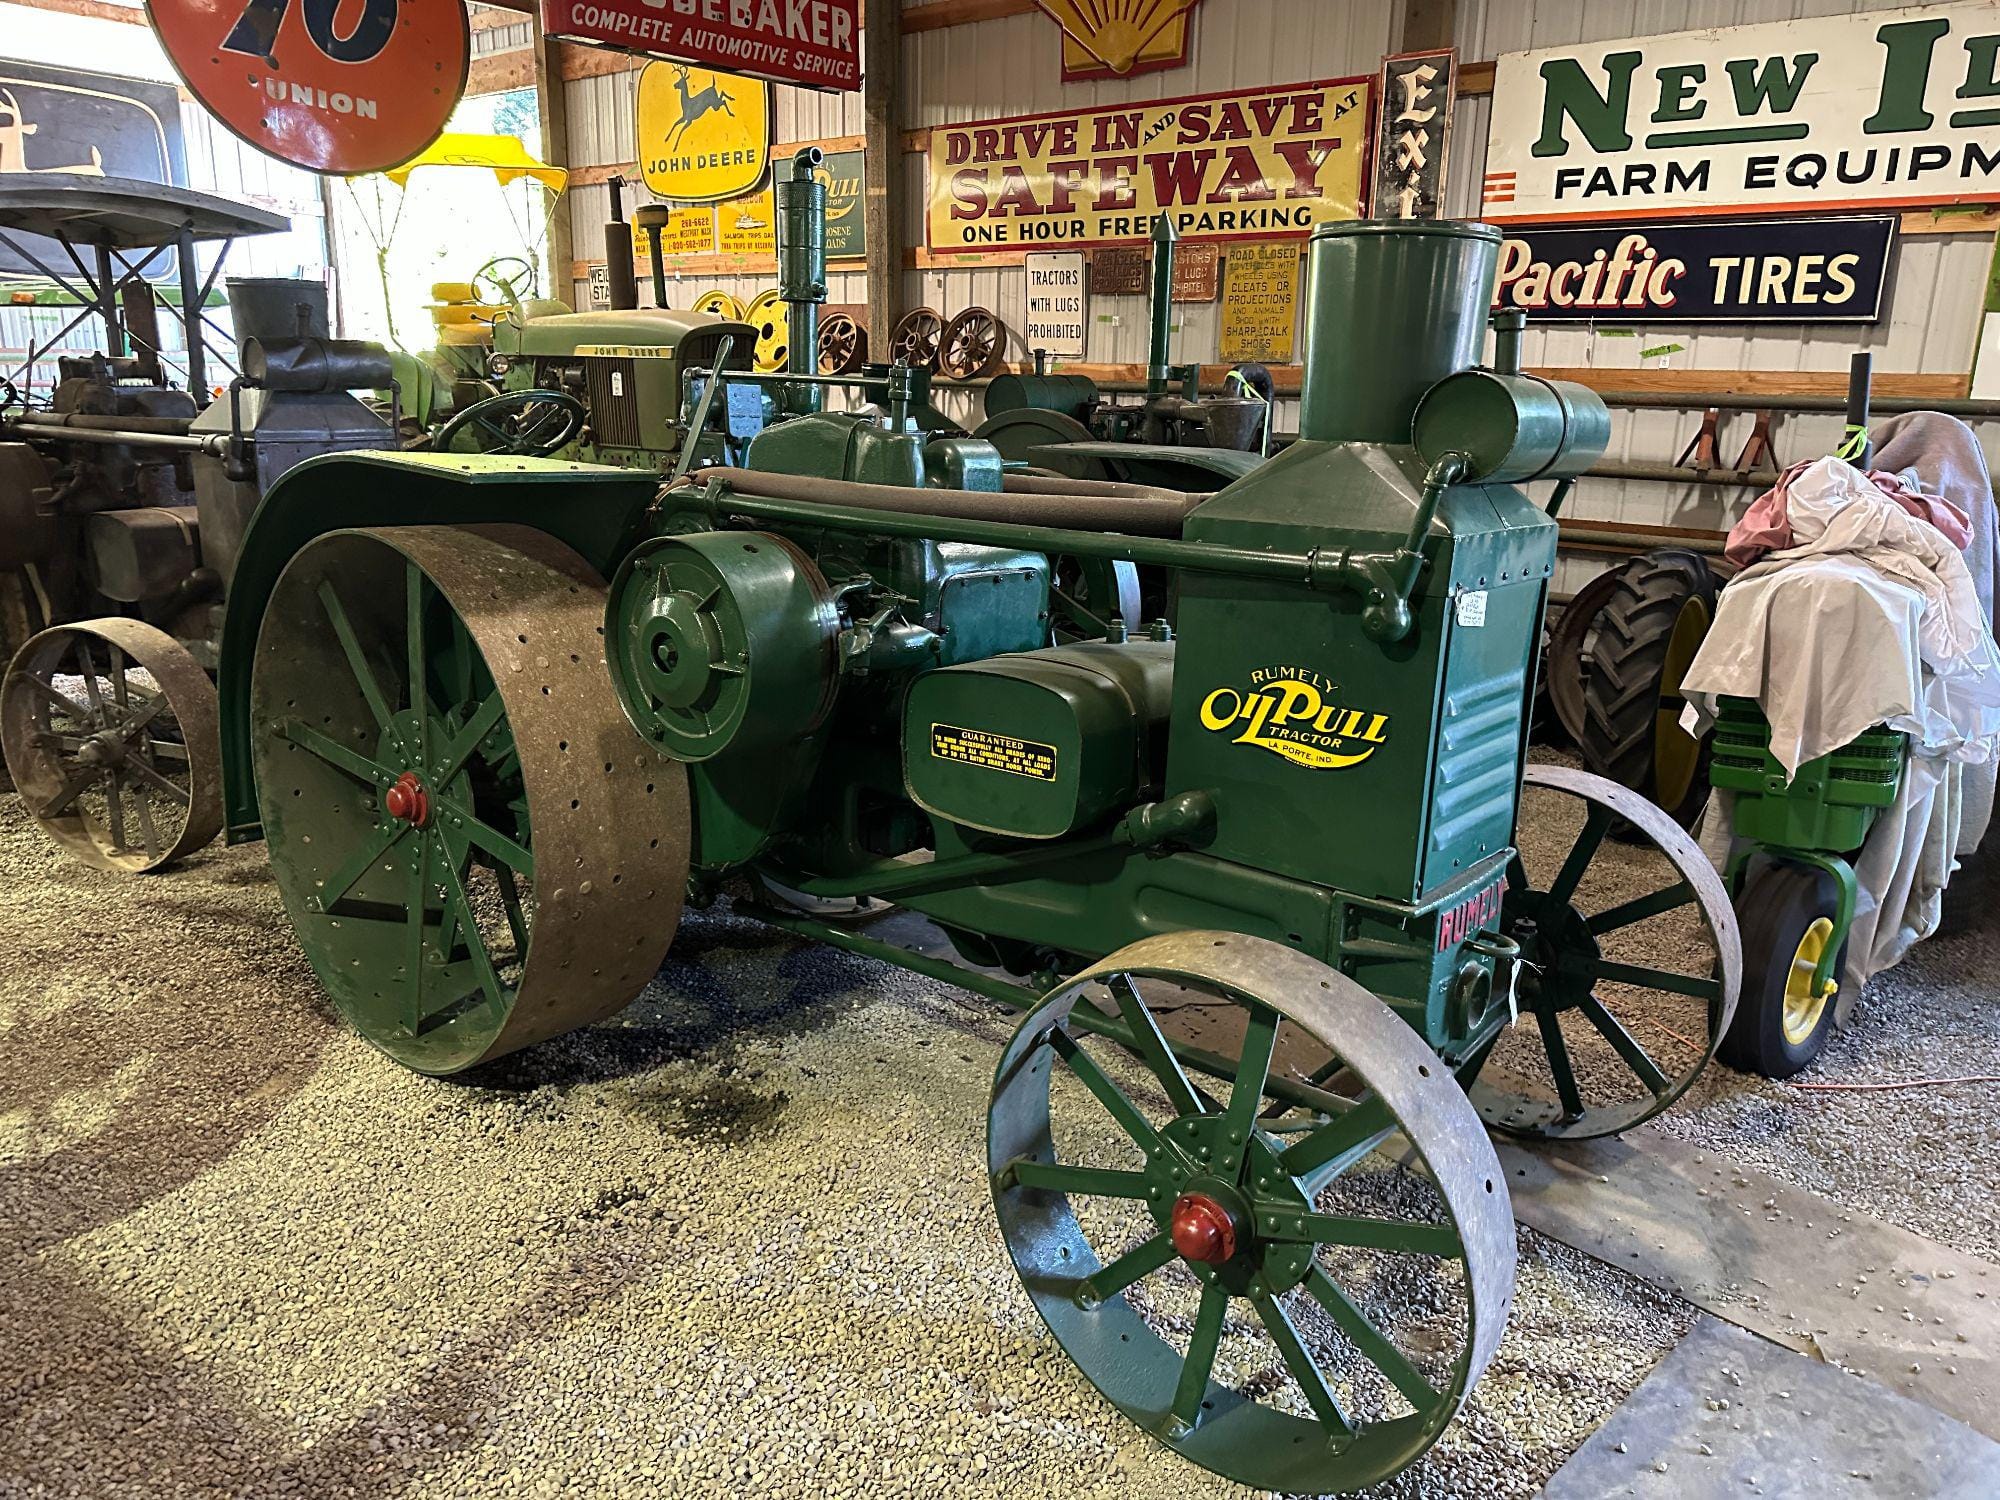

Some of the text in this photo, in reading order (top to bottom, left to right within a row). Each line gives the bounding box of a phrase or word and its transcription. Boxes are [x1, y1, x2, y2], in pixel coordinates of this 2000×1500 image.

[571, 3, 854, 80] COMPLETE AUTOMOTIVE SERVICE
[266, 77, 377, 120] UNION
[946, 91, 1358, 165] DRIVE IN AND SAVE AT
[648, 149, 756, 175] JOHN DEERE
[950, 138, 1342, 220] SAFEWAY
[1555, 143, 2000, 199] FARM EQUIPM
[962, 224, 1008, 243] ONE
[1019, 219, 1085, 241] HOUR
[1178, 206, 1312, 233] PARKING
[1229, 248, 1296, 260] ROAD CLOSED
[1277, 260, 1296, 269] WITH
[1490, 234, 1860, 310] Pacific TIRES
[1031, 270, 1078, 286] TRACTORS
[1234, 271, 1288, 280] WHEELS USING
[1231, 281, 1290, 292] CLEATS OR
[1031, 297, 1079, 312] WITH LUGS
[1228, 294, 1292, 305] PROJECTIONS
[1231, 306, 1285, 315] AND ANIMALS
[1028, 324, 1081, 339] PROHIBITED
[594, 347, 661, 357] JOHN DEERE
[1240, 339, 1272, 349] SHOES
[1251, 666, 1339, 694] RUMELY
[961, 731, 1024, 750] GUARANTEED
[1268, 740, 1279, 749] LA
[1269, 726, 1343, 749] TRACTOR
